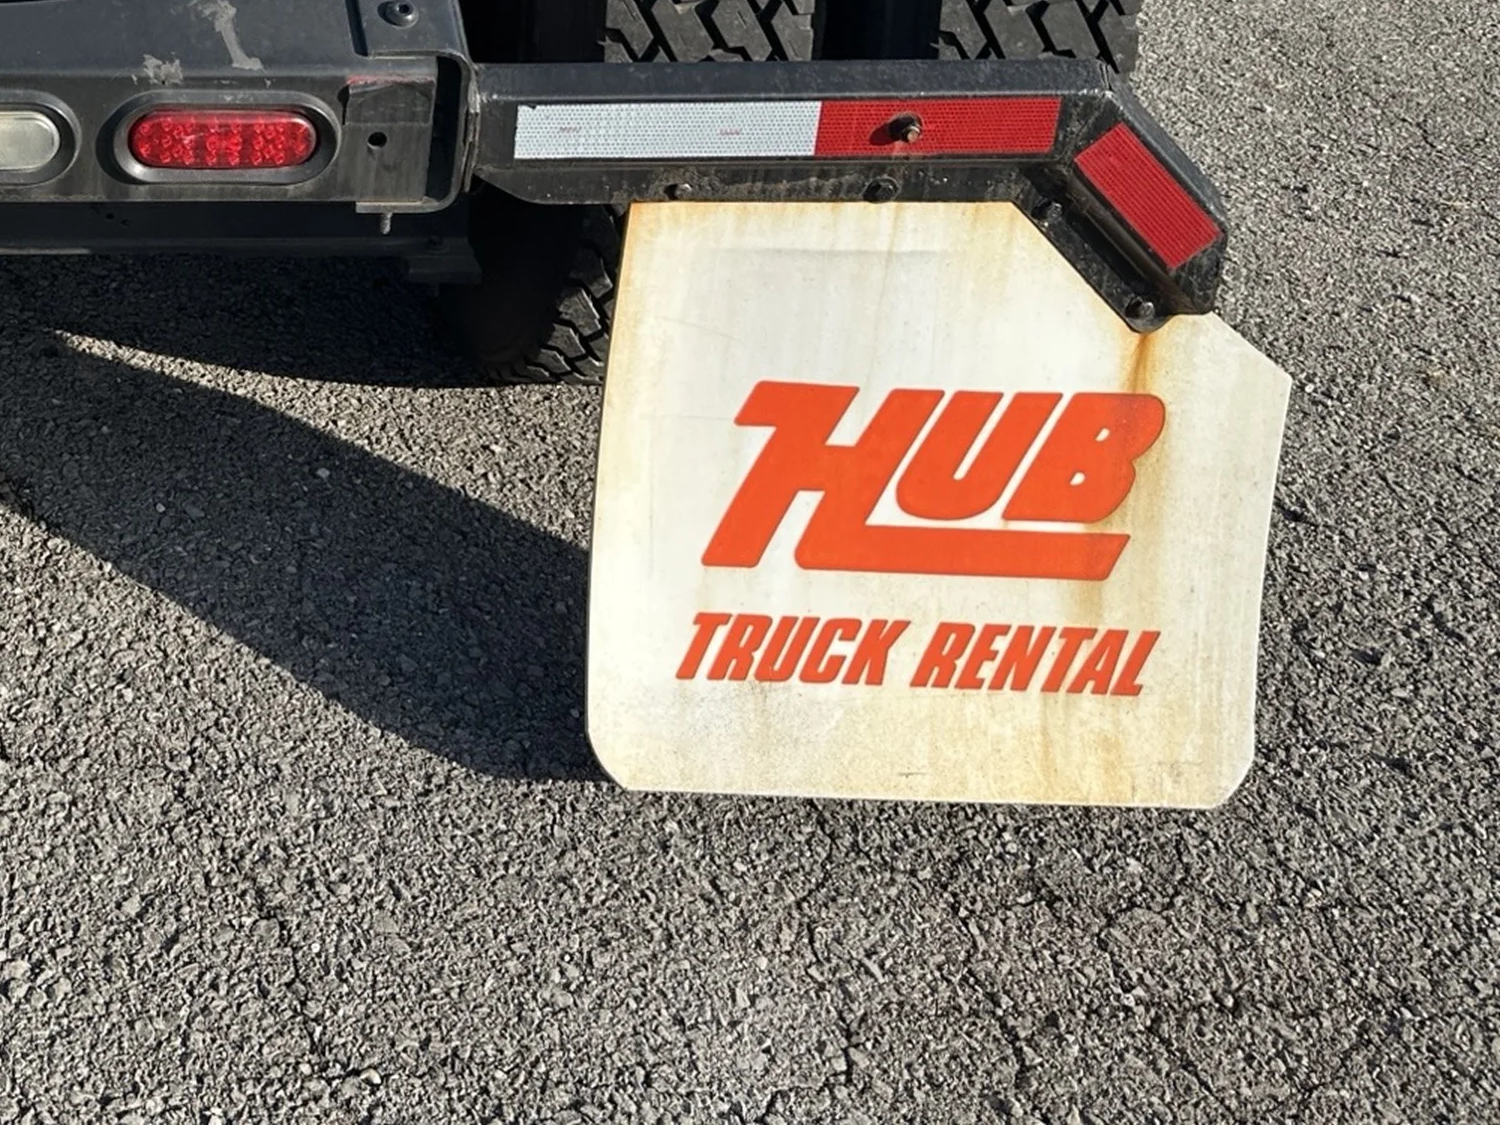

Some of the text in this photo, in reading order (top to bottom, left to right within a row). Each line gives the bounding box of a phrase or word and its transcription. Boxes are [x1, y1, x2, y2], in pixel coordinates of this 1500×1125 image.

[701, 380, 1165, 581] HUB
[675, 612, 1161, 697] TRUCK RENTAL
